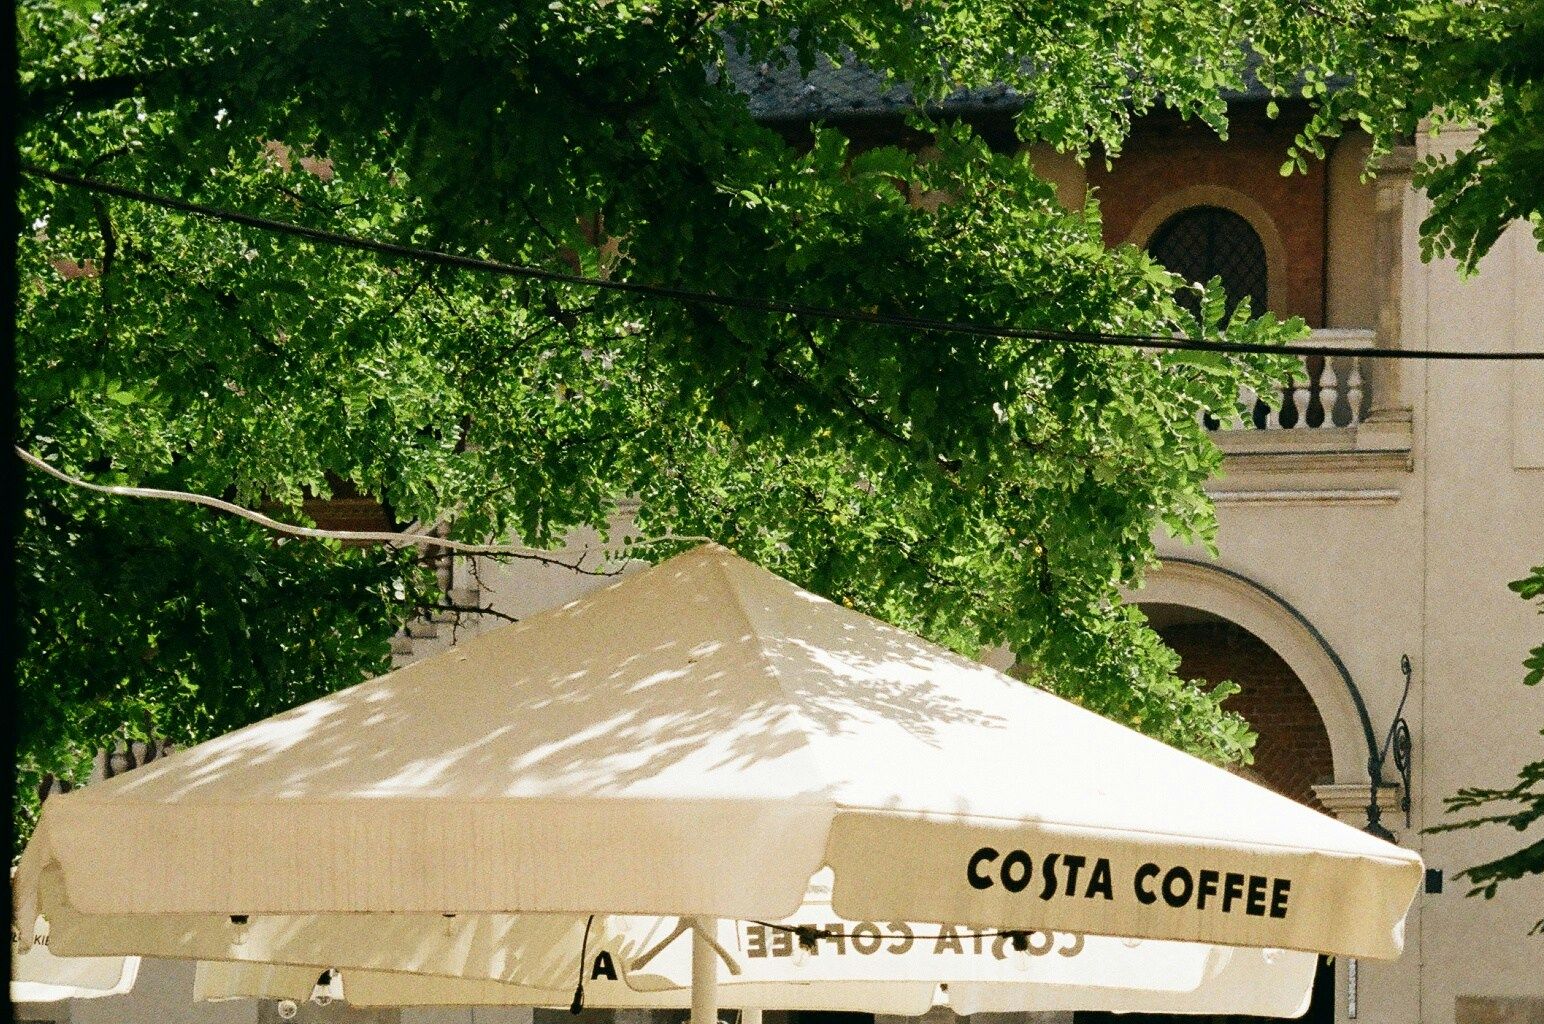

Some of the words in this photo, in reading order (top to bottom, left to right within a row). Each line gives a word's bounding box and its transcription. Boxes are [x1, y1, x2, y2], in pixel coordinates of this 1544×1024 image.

[967, 847, 1114, 901] COSTA
[1134, 863, 1291, 919] COFFEE
[590, 950, 618, 981] A
